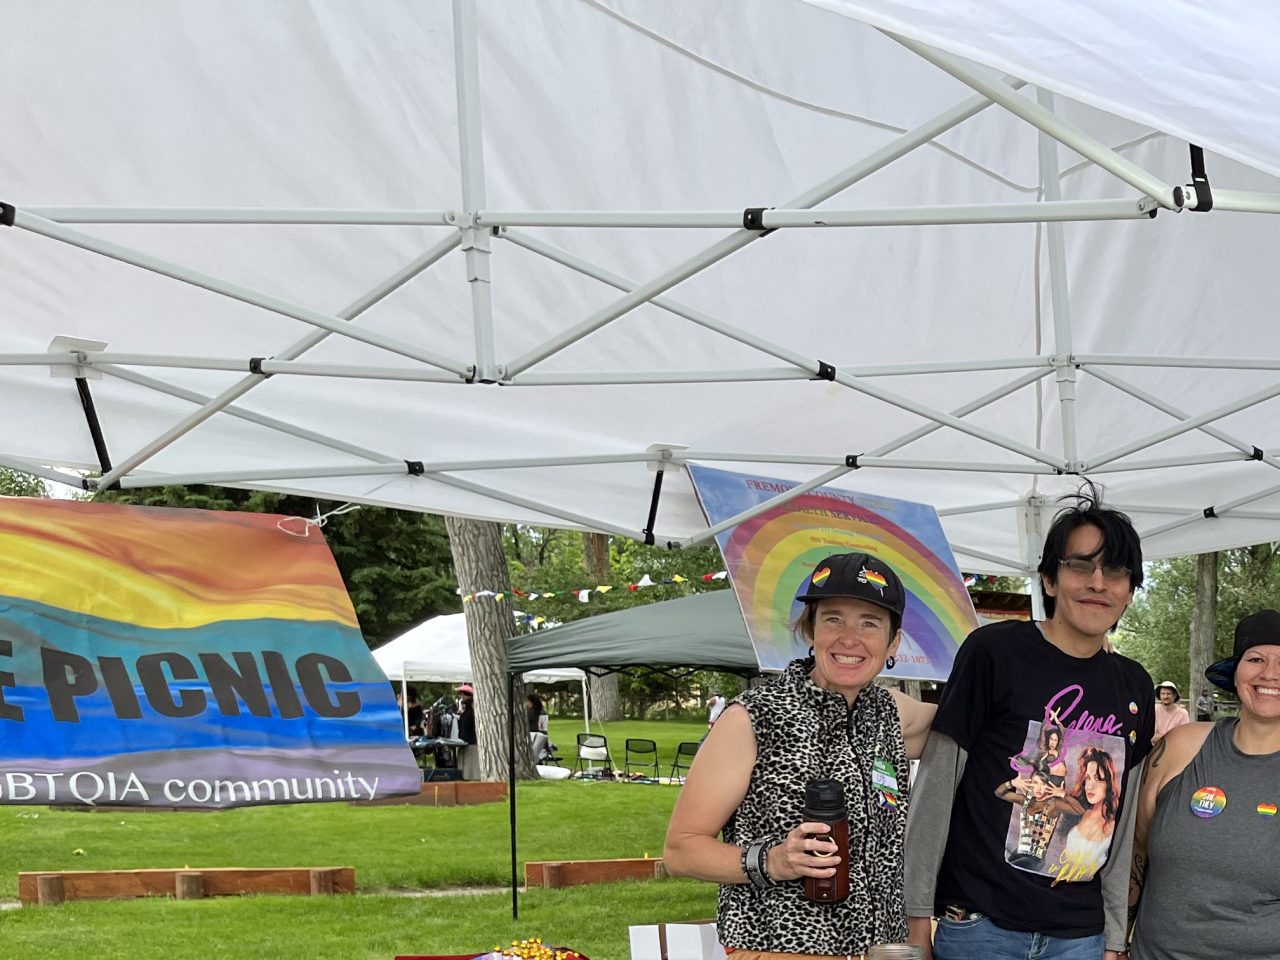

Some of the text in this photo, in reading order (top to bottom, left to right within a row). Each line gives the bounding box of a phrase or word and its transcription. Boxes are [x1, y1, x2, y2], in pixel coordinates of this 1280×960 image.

[746, 479, 797, 496] FREMO
[41, 647, 363, 723] PICNIC
[0, 769, 380, 806] BTQIA community
